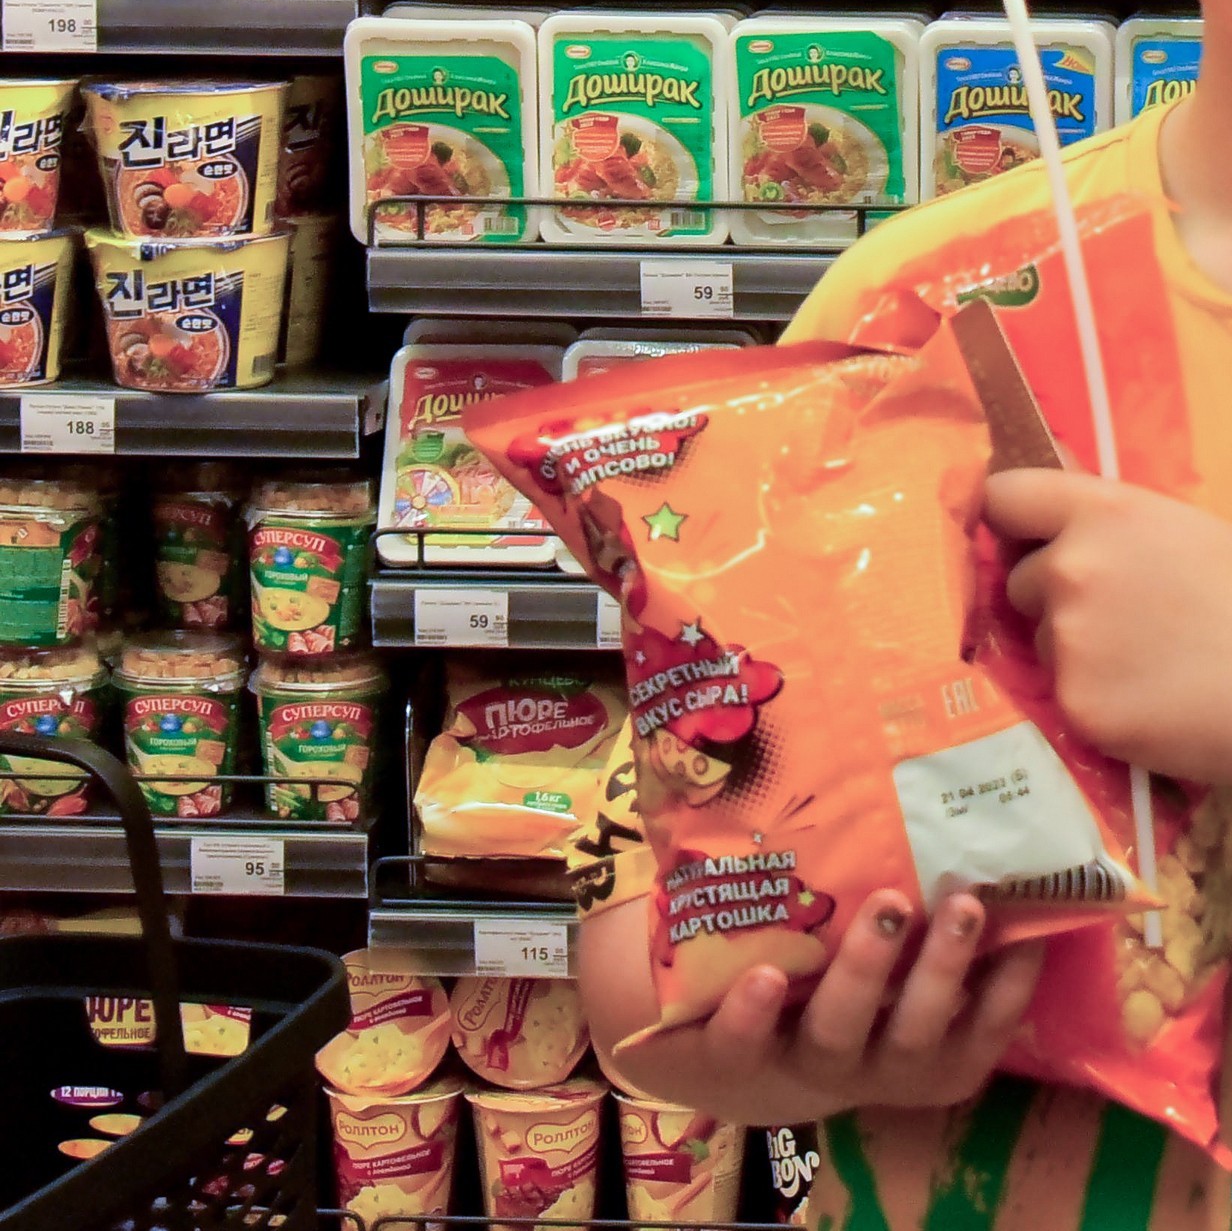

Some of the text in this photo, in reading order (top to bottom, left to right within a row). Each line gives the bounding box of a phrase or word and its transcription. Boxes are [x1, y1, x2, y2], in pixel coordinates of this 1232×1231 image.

[48, 18, 76, 33] 198
[562, 72, 701, 112] Доширак
[747, 62, 887, 107] Доширак
[372, 87, 511, 124] Доширак
[944, 83, 1085, 123] Дошиак
[118, 115, 237, 169] 진라면
[106, 268, 216, 320] 진라면
[693, 285, 713, 300] 59
[66, 420, 95, 436] 188
[583, 436, 661, 464] ОЧЕНЬ
[254, 529, 327, 554] СУПЕРСУП
[469, 614, 489, 630] 59
[629, 651, 740, 706] СЕКРЕТНЫЙ
[134, 696, 213, 716] СУПЕРСУП
[281, 703, 361, 721] СУПЕРСУП
[484, 697, 569, 730] ПЮРЕ
[634, 683, 749, 737] ВКУС СЫРА!
[245, 861, 265, 876] 95
[669, 903, 789, 943] КАРТОШКА
[521, 947, 548, 961] 115
[338, 1118, 402, 1137] Роллтон
